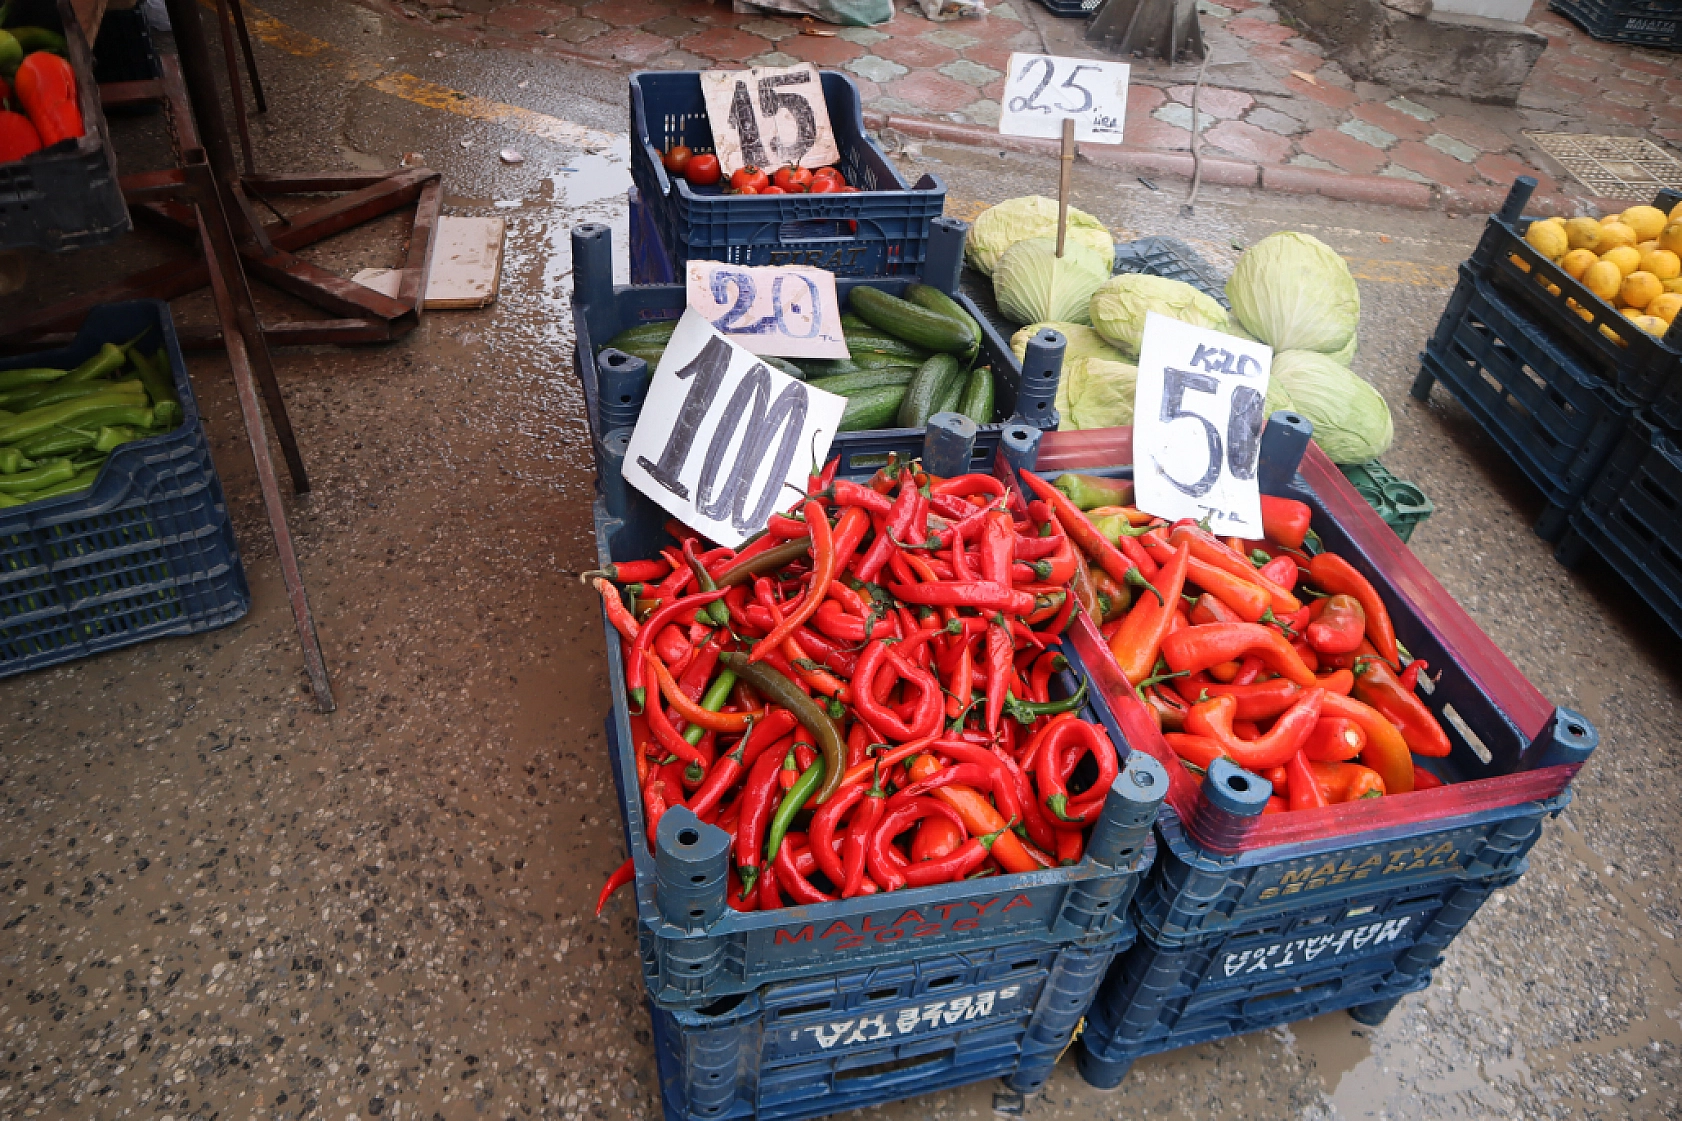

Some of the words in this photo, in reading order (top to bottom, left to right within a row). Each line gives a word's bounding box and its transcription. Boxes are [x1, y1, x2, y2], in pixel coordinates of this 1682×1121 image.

[1008, 57, 1102, 114] 25
[728, 70, 816, 167] 15
[768, 247, 867, 267] FIRAT
[709, 268, 821, 338] 20
[636, 334, 809, 536] 100
[1150, 366, 1266, 498] 50
[1280, 841, 1453, 885] MALATYA
[773, 894, 1034, 946] MALATYA
